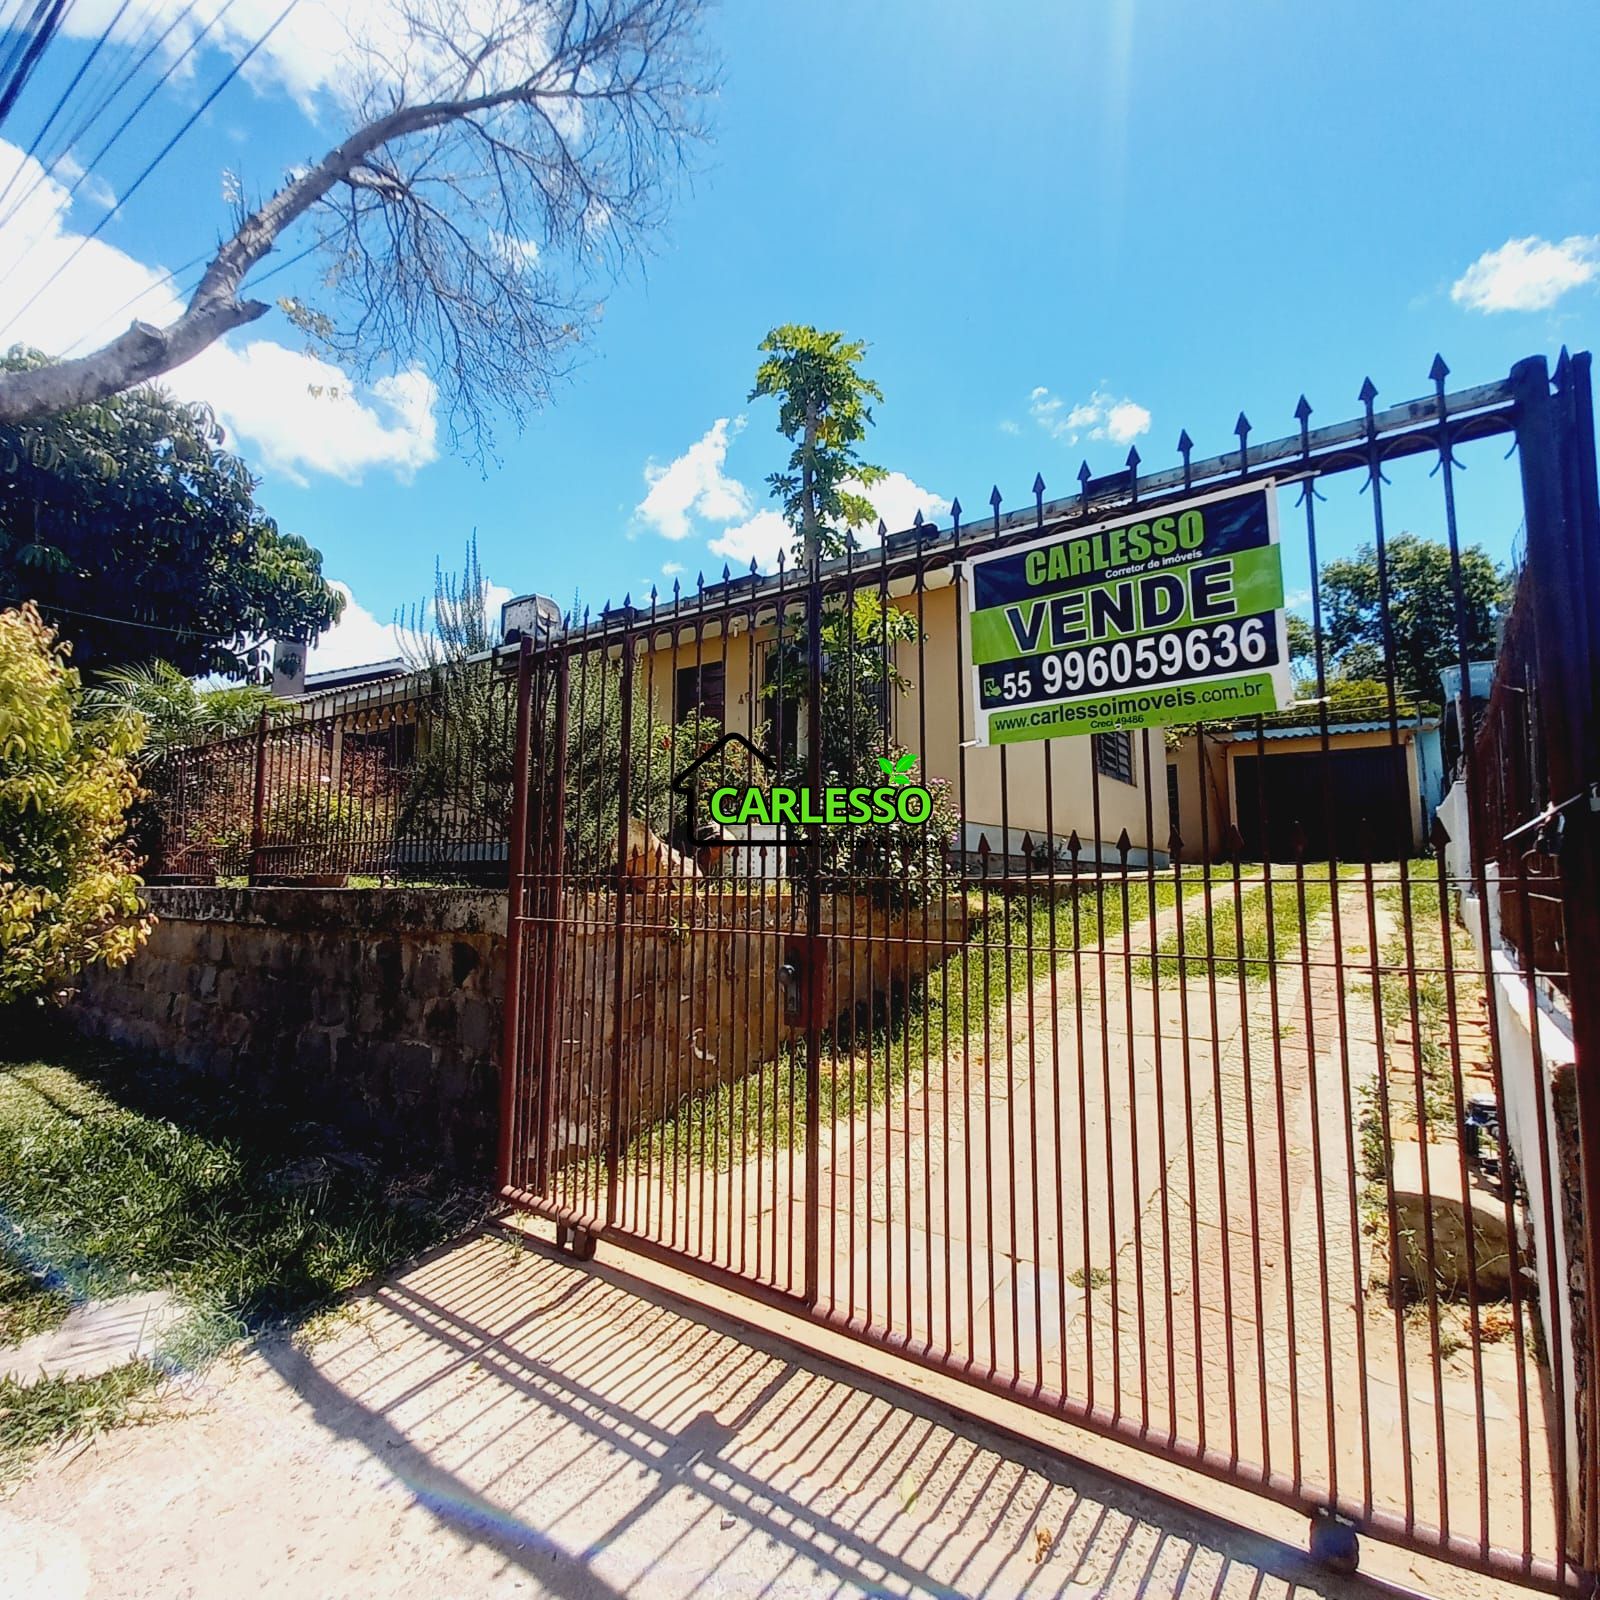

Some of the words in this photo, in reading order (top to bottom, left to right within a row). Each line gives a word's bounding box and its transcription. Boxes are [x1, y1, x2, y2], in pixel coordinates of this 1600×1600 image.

[1025, 510, 1204, 586] CARLESSO
[1105, 563, 1146, 579] Corretor
[1147, 558, 1160, 569] de
[1162, 550, 1203, 566] imóveis
[1004, 559, 1237, 654] VENDE
[1003, 670, 1032, 700] 55
[1042, 618, 1267, 695] 996059636
[995, 682, 1262, 732] www.carlessoimoveis.com.br
[1090, 719, 1113, 729] Creci
